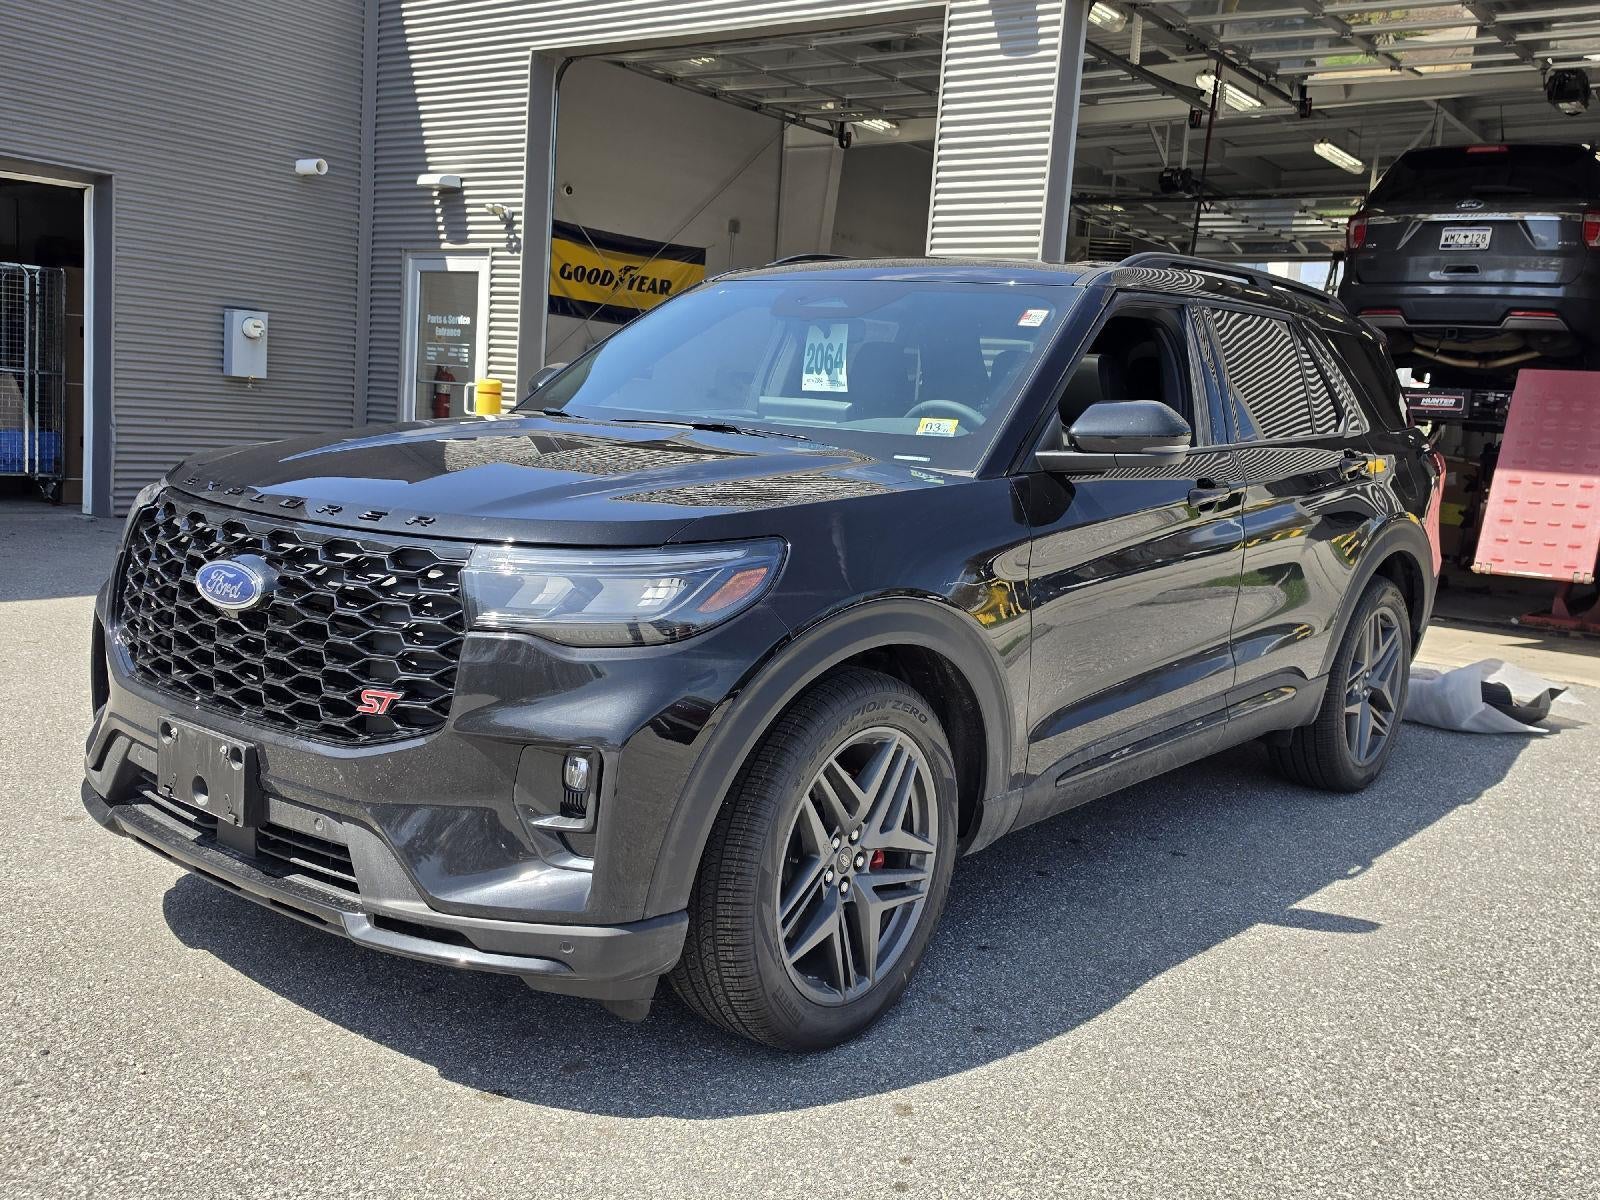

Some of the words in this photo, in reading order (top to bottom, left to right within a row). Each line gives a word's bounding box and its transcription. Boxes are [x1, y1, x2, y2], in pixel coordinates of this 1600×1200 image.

[1444, 233, 1462, 243] WMZ
[1470, 233, 1487, 243] 128
[427, 314, 442, 323] Parts
[448, 315, 471, 324] Service
[436, 327, 461, 336] Entrance
[805, 343, 844, 375] 2064
[1420, 398, 1456, 407] HUNTER
[205, 569, 242, 599] Ford
[356, 689, 405, 715] ST
[892, 700, 928, 725] ZERO
